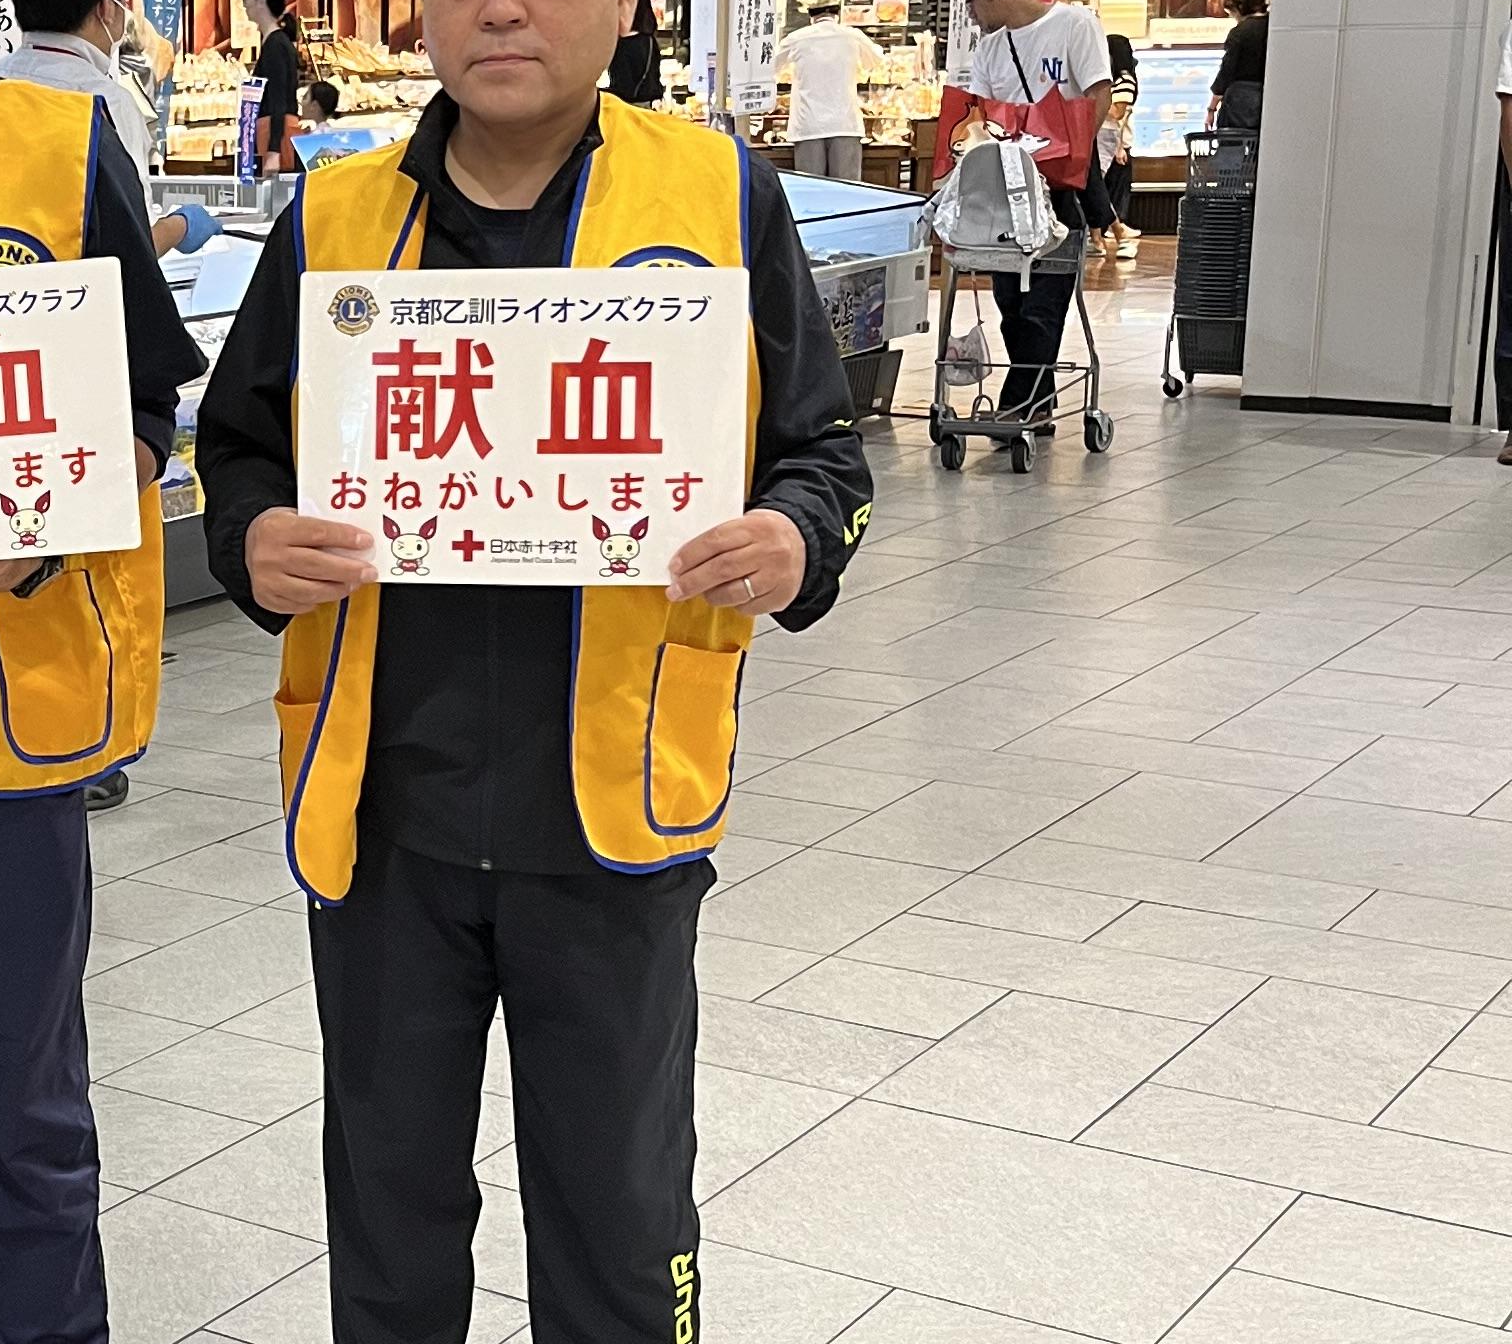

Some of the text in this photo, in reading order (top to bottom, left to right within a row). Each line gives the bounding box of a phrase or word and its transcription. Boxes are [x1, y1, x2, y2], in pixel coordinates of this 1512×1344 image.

[389, 294, 712, 326] 京都乙訓ライオンズクラブ
[372, 336, 664, 461] 献血
[329, 470, 704, 513] おねがいします
[490, 539, 578, 555] 日本赤十字社
